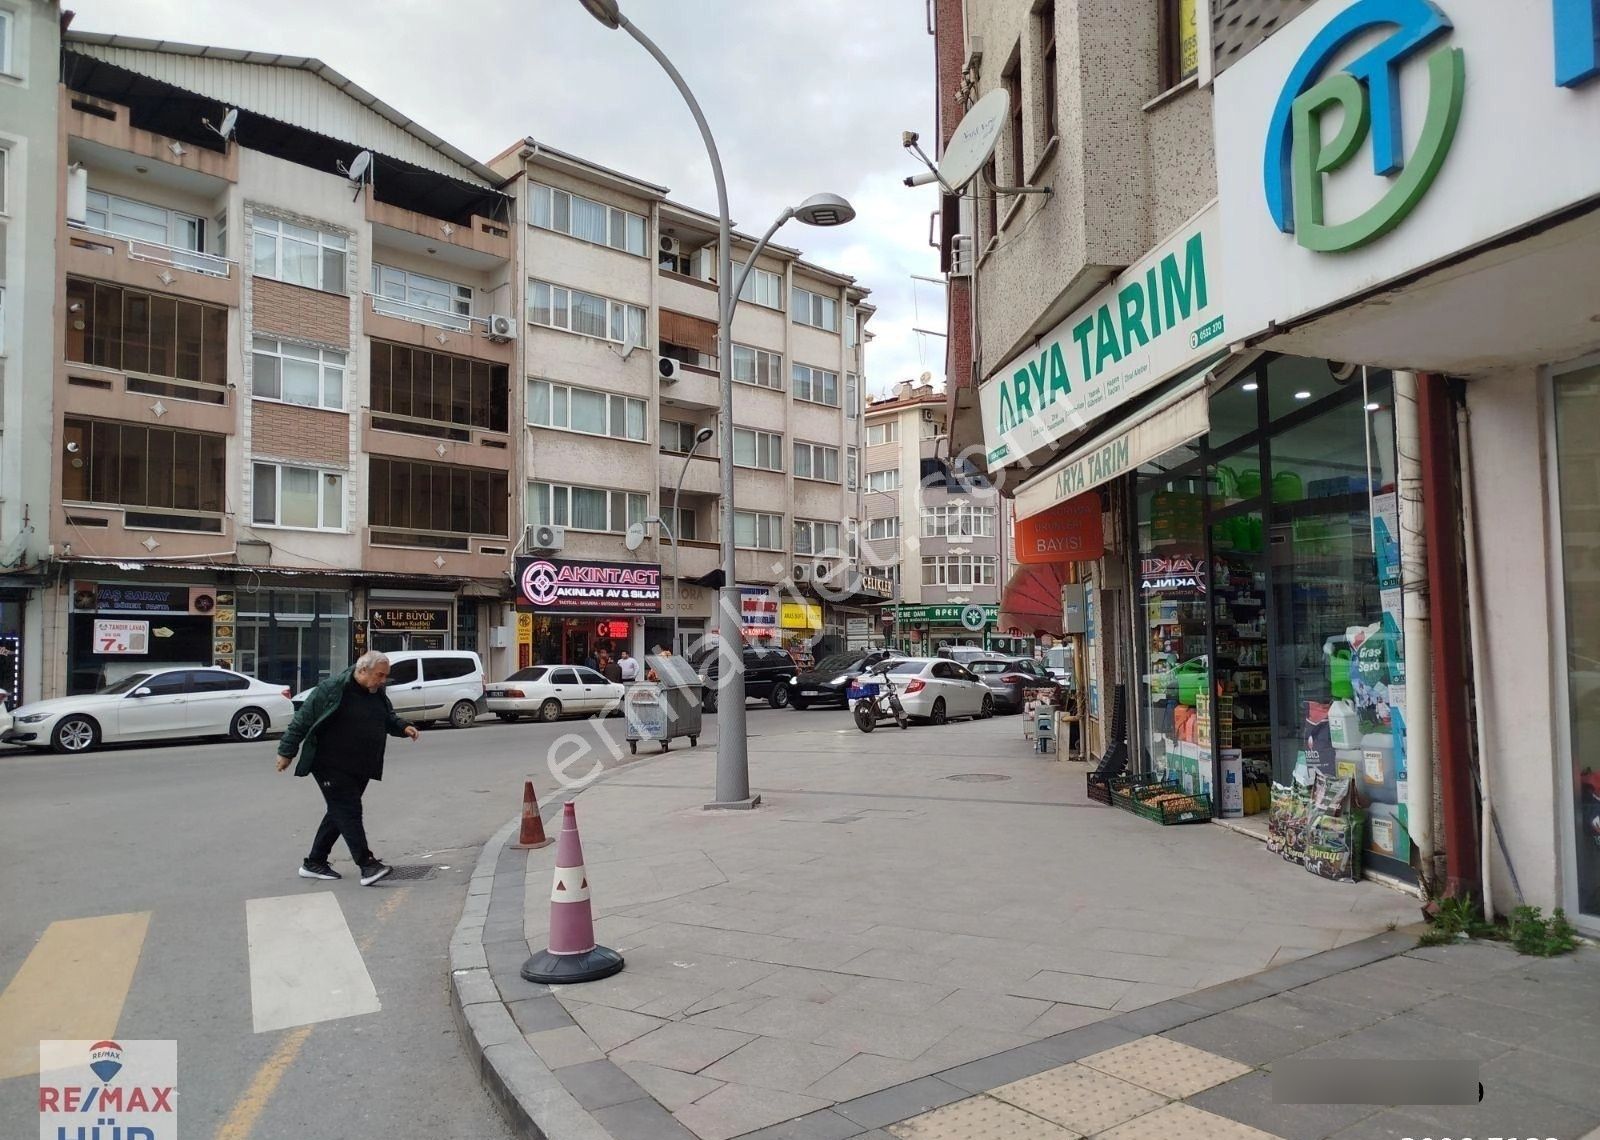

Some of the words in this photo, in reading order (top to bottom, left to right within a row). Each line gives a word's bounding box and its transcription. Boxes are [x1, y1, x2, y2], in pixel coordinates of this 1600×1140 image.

[1000, 341, 1071, 436] ARYA
[1073, 231, 1208, 382] TARIM
[1055, 466, 1084, 499] ARYA
[1087, 435, 1130, 474] TARIM
[558, 565, 660, 585] AKINTACT
[557, 588, 604, 598] AKINLAR
[606, 590, 620, 598] AV
[621, 590, 629, 598] &
[935, 608, 959, 616] APEK
